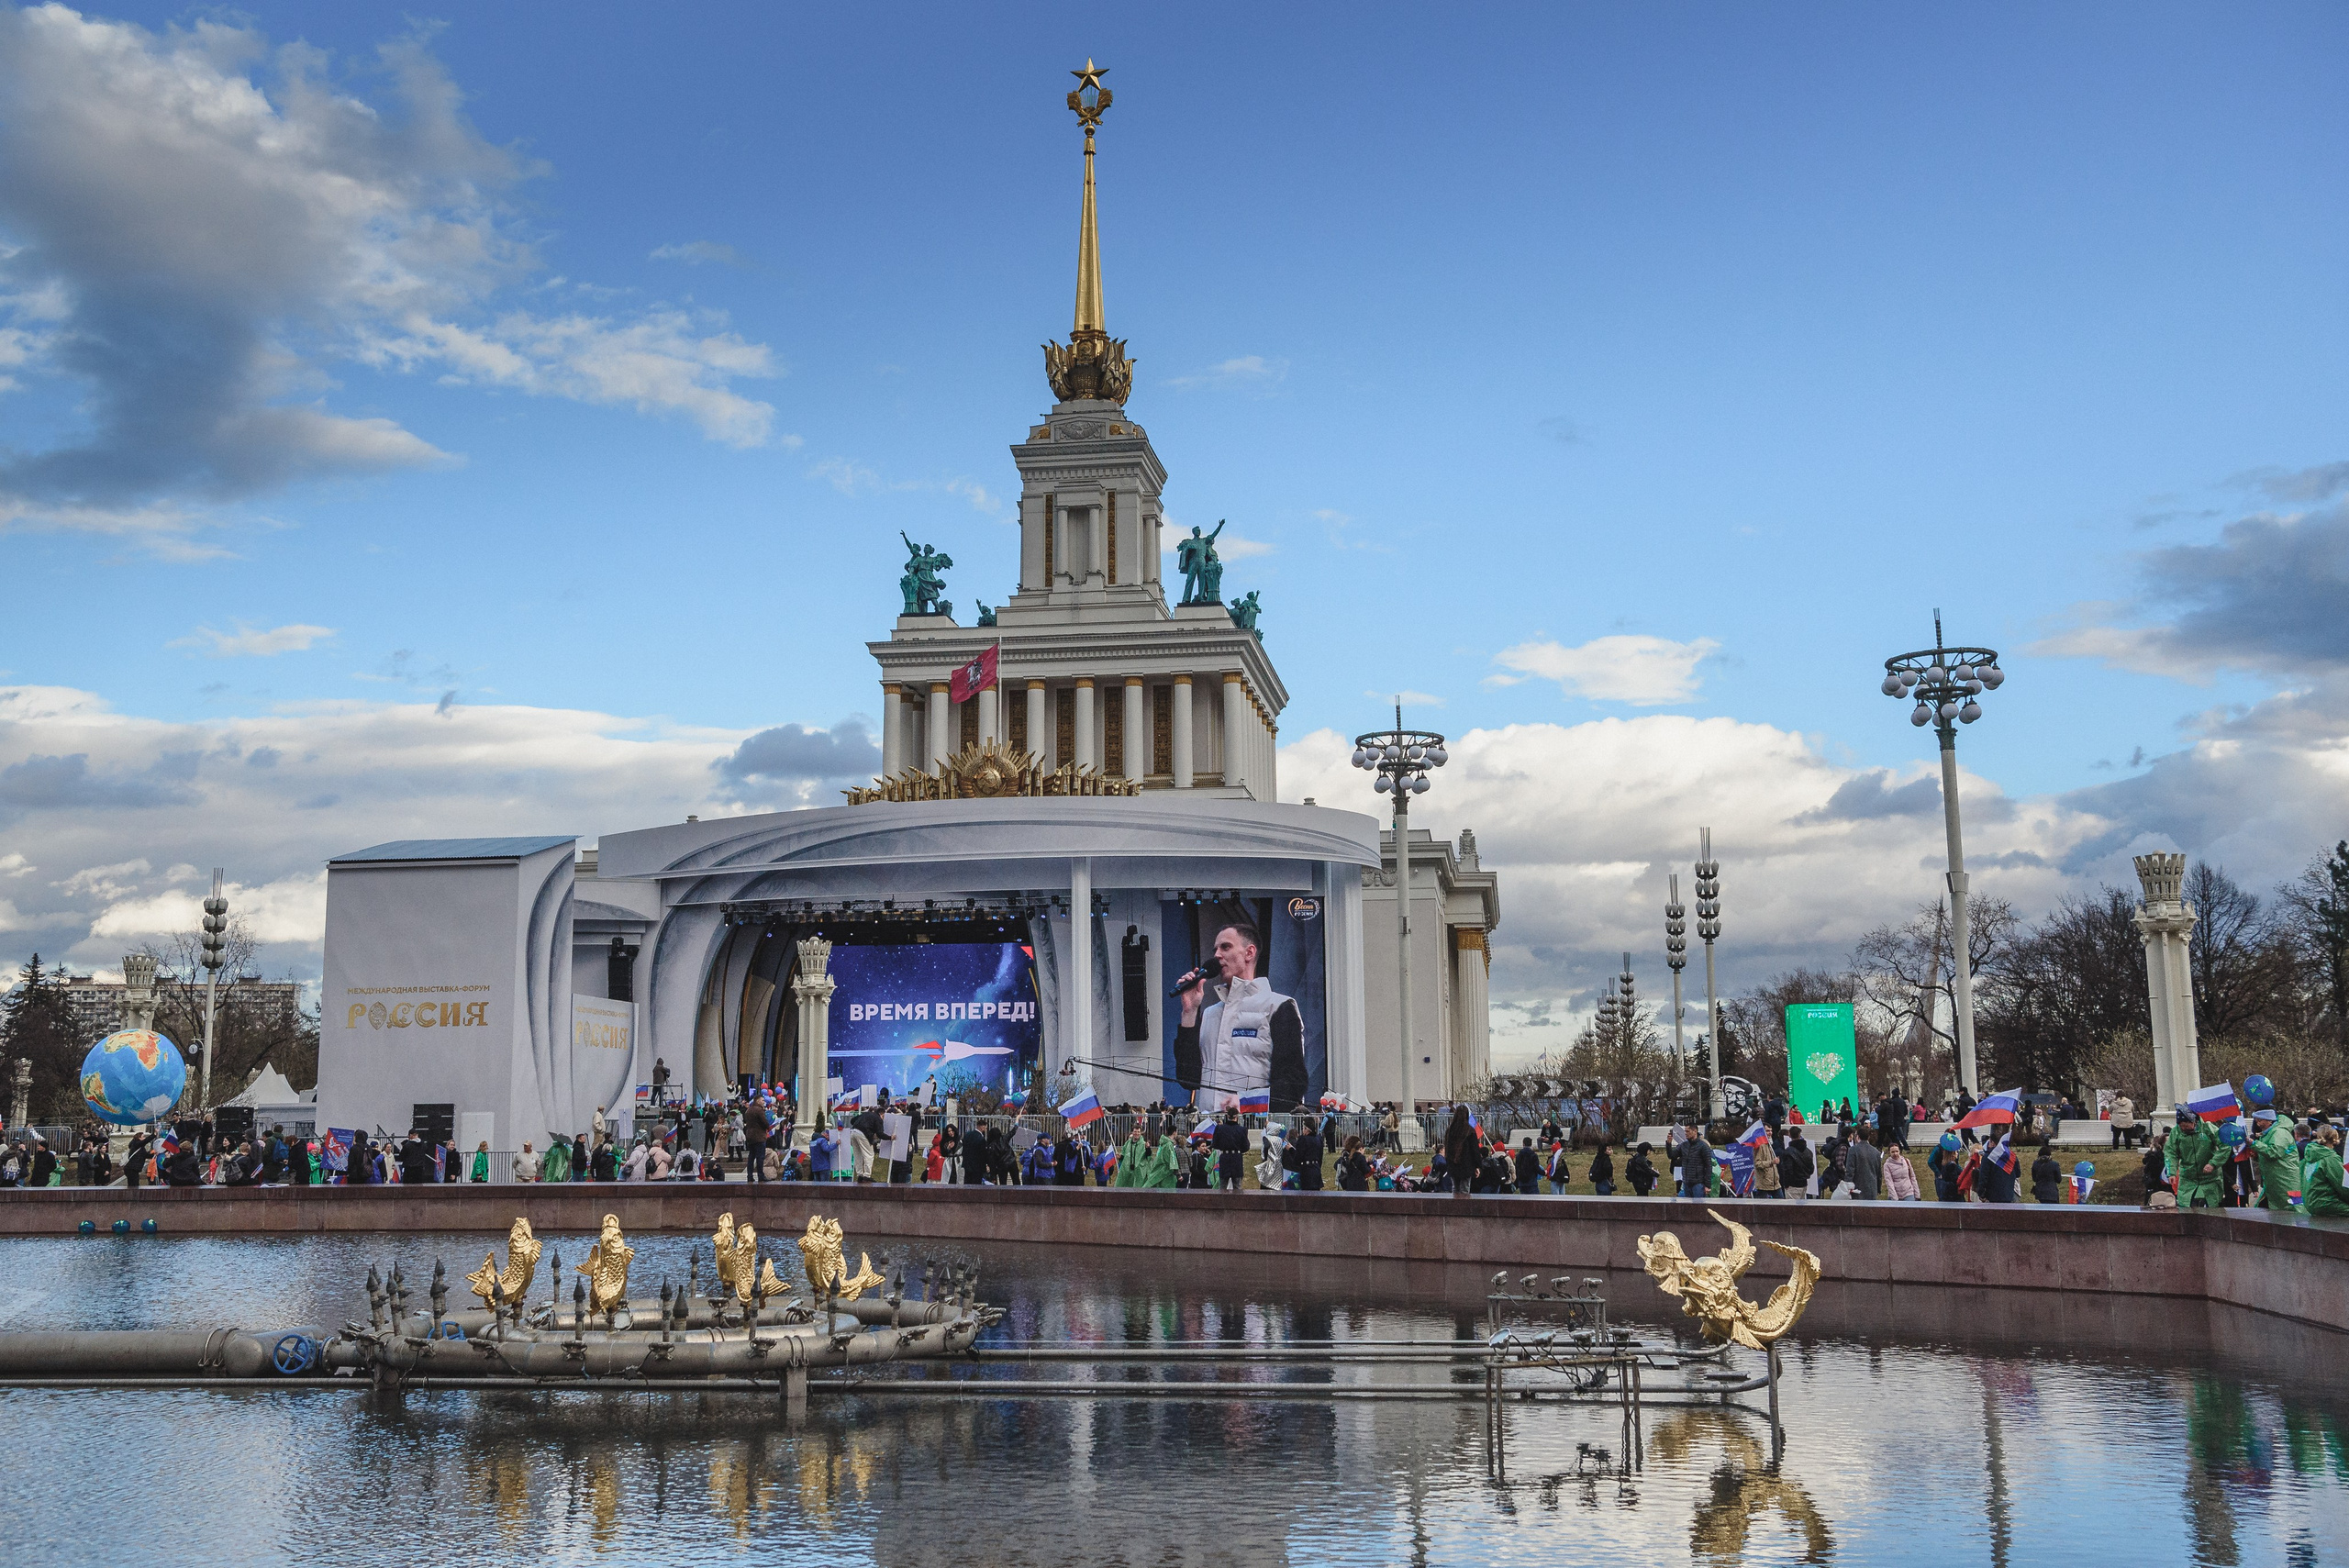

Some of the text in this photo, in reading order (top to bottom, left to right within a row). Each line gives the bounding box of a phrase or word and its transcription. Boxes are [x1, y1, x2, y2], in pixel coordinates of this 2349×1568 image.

[347, 984, 490, 995] МЕЖДУНАРОДНАЯ ВЫСТАВКА-ФОРУМ
[346, 1001, 489, 1029] РОССИЯ
[850, 1001, 1035, 1022] ВРЕМЯ ВПЕРЕД!
[574, 1020, 629, 1050] РОССИЯ
